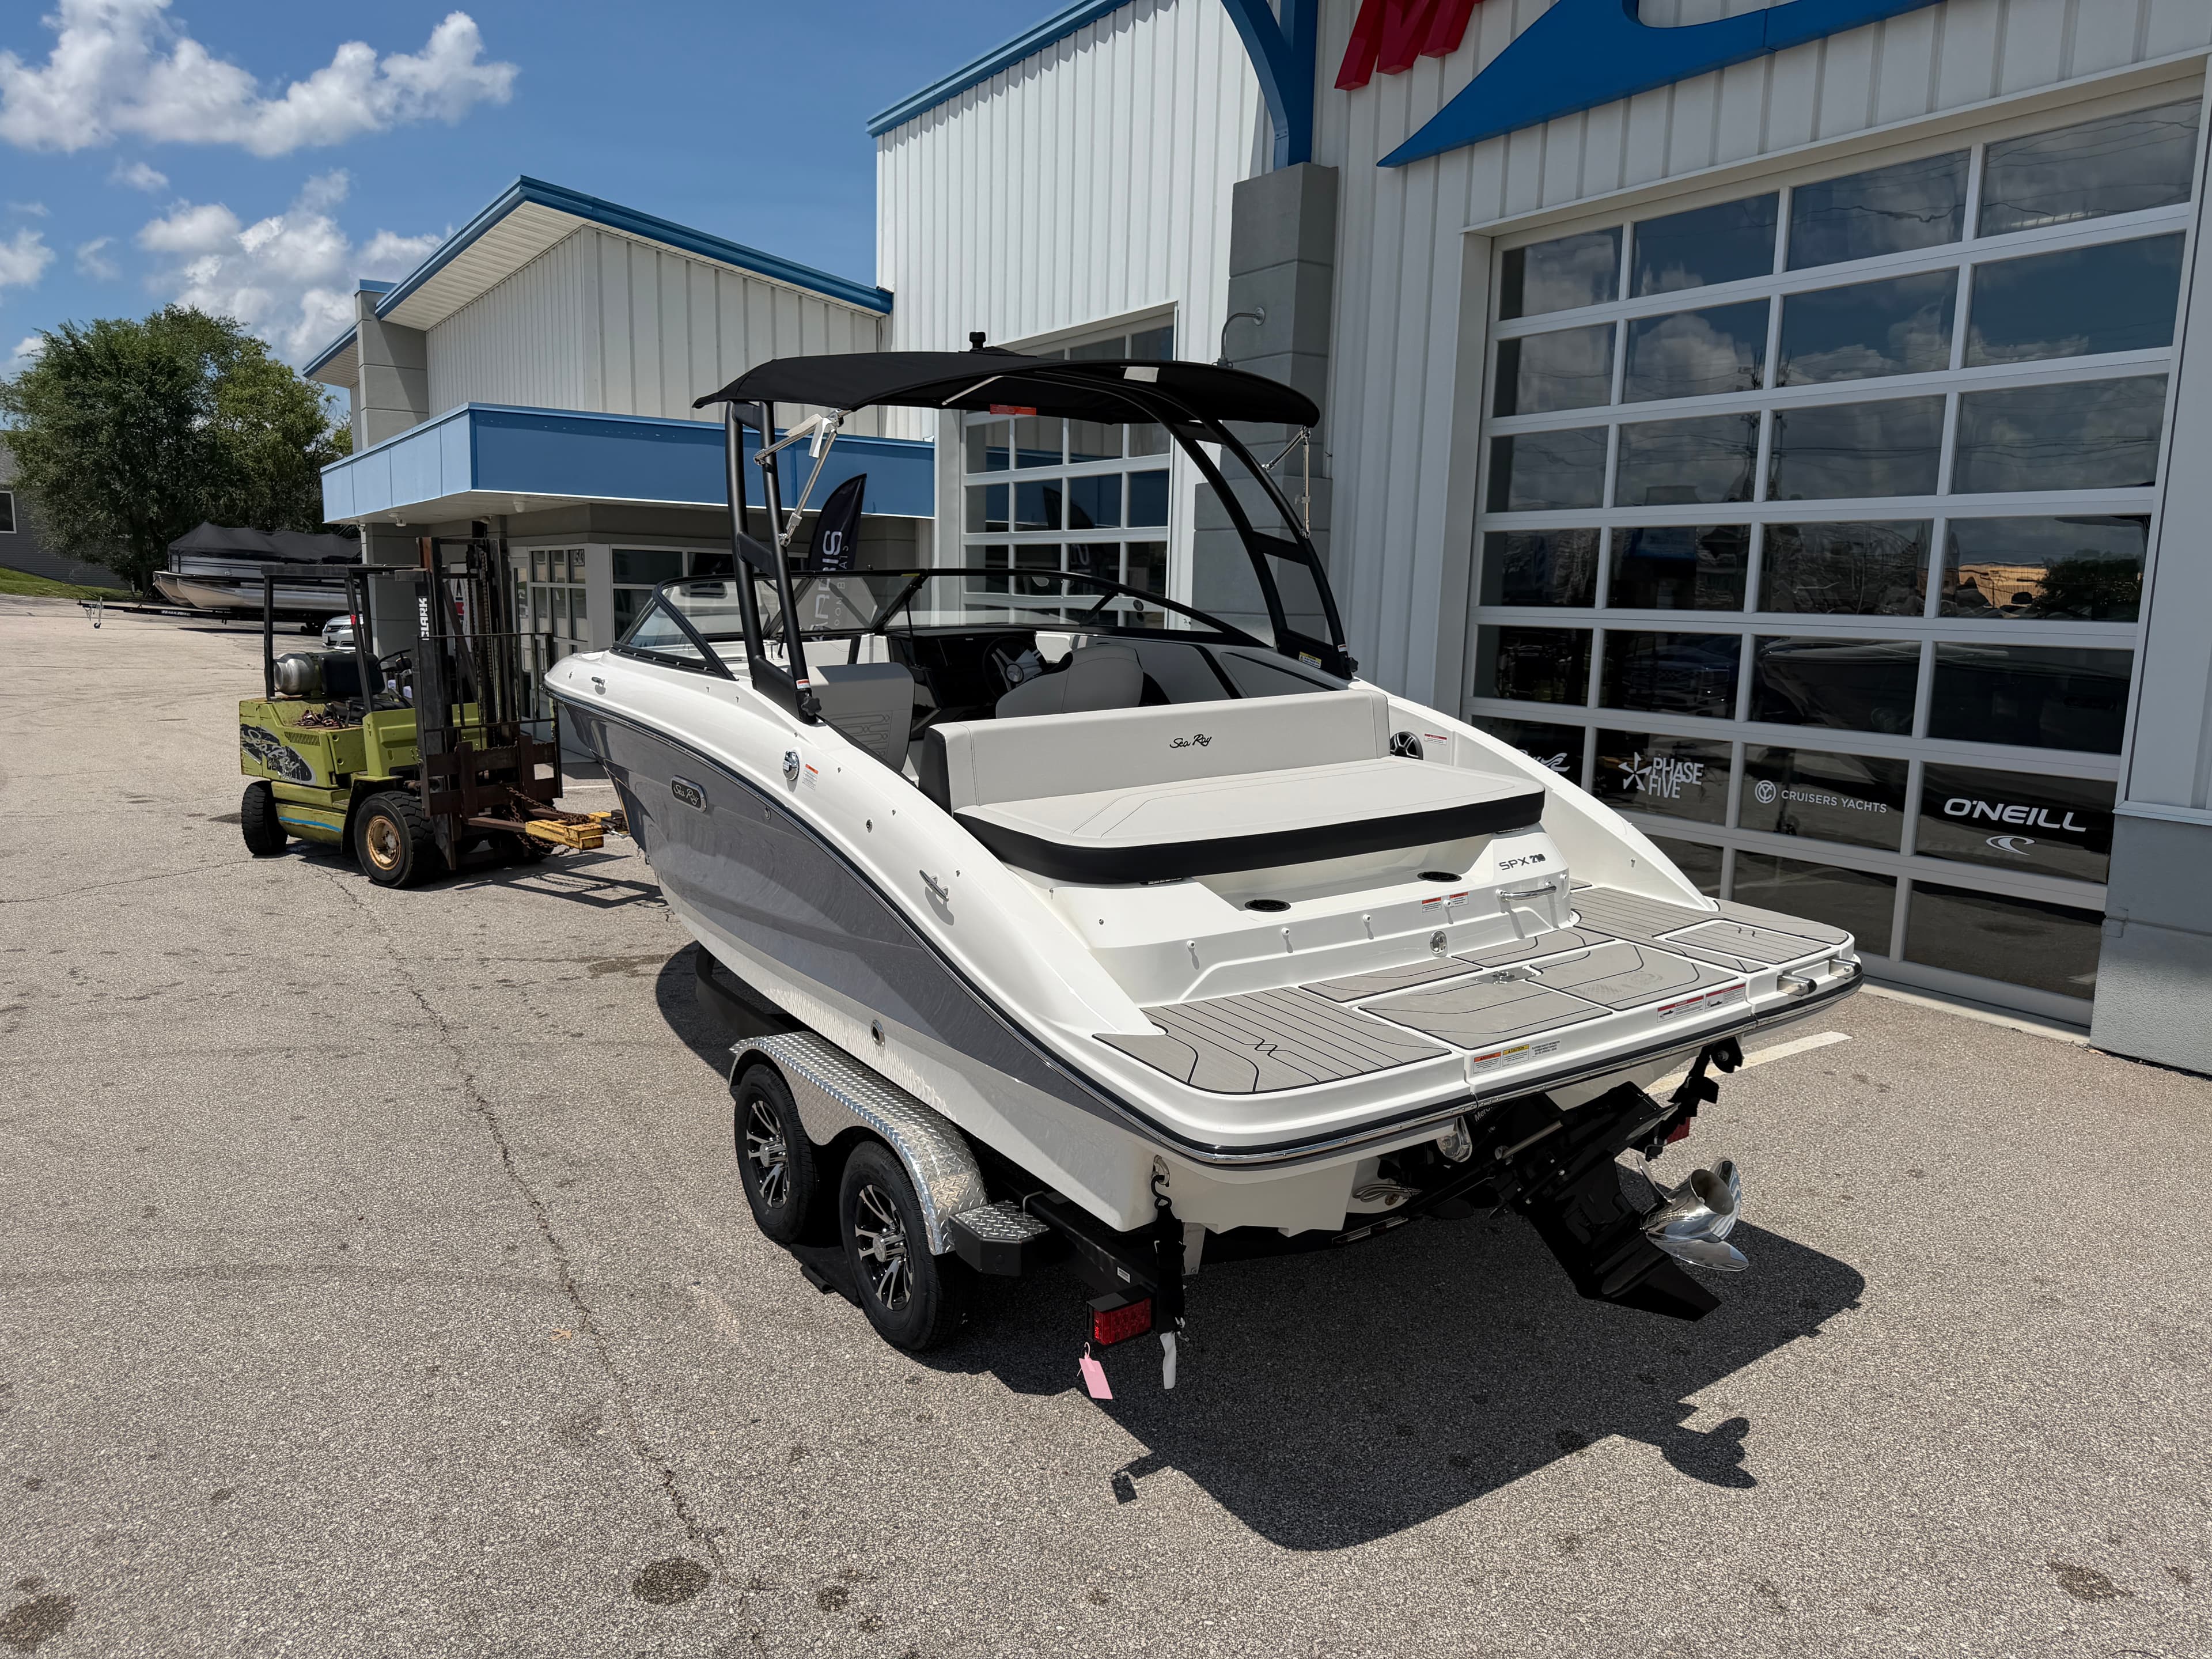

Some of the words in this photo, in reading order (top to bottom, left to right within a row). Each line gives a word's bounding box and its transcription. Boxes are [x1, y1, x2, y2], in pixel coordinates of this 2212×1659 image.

[418, 597, 430, 641] CLARK
[1169, 738, 1191, 748] Sea
[1192, 734, 1212, 747] Ray
[1652, 757, 1705, 785] PHASE
[673, 785, 685, 797] Sea
[686, 789, 699, 805] Ray
[1648, 774, 1681, 799] FIVE
[1781, 790, 1838, 806] CRUISERS
[1841, 797, 1887, 813] YACHTS
[1944, 798, 2087, 832] O'NEILL
[1499, 857, 1530, 870] SPX
